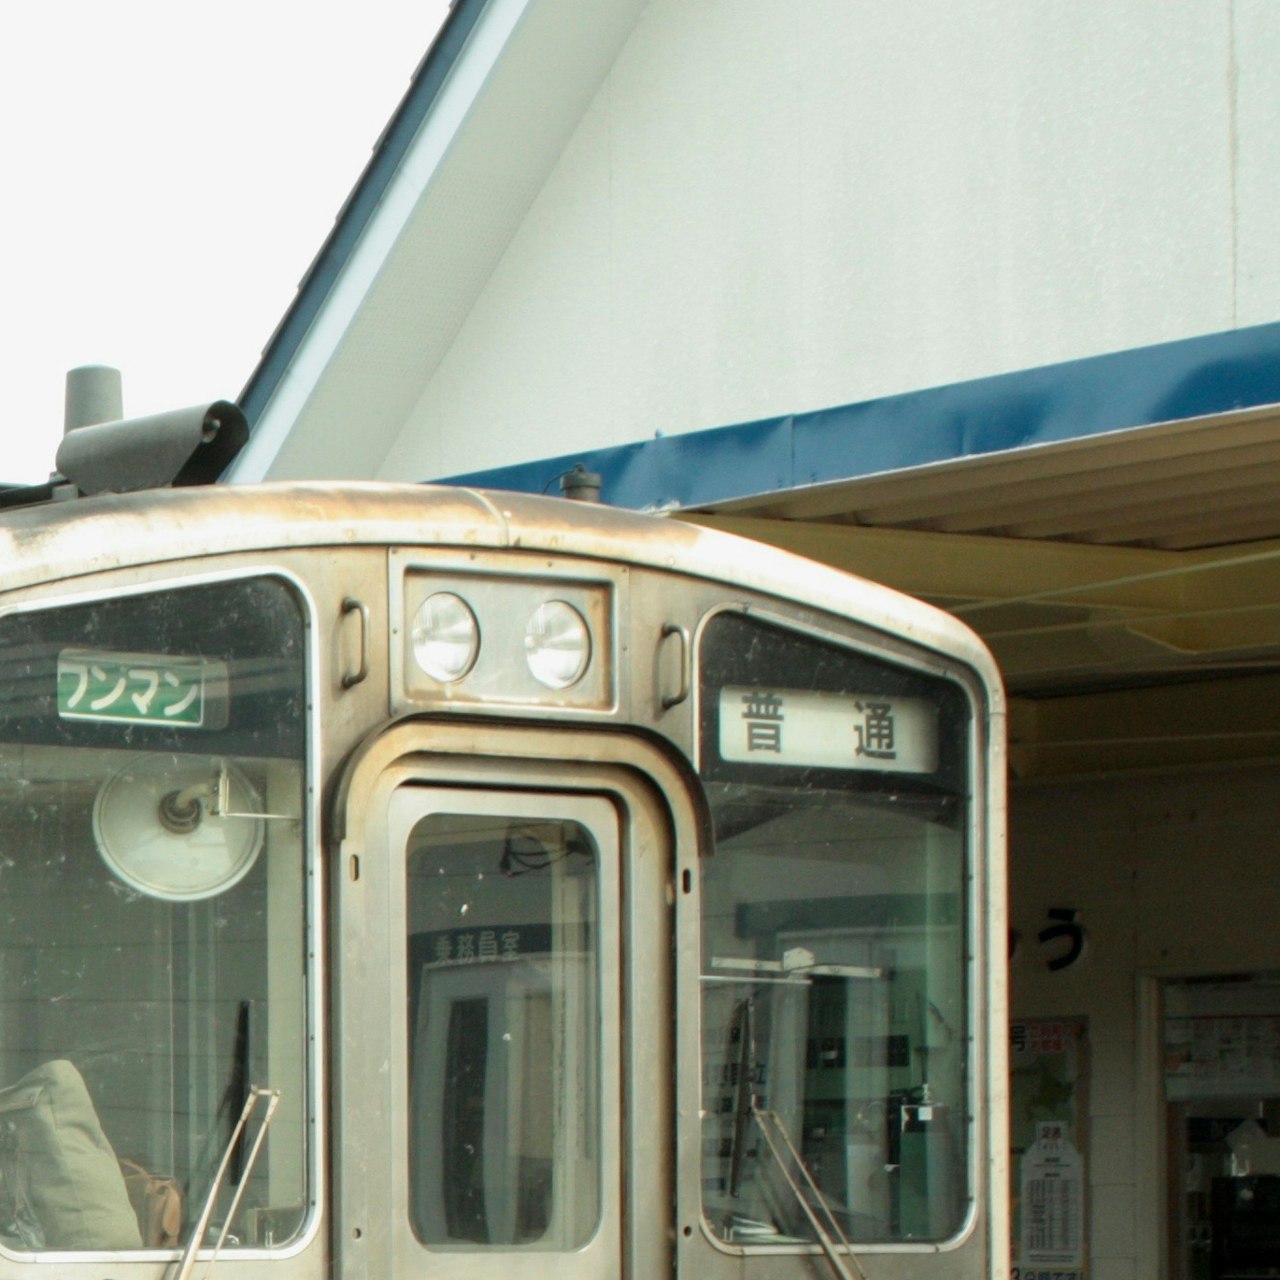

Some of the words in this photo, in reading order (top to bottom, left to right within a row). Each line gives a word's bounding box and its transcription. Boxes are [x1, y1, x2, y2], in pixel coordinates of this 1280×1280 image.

[57, 663, 198, 716] ワンマン
[741, 691, 897, 760] 普通
[436, 930, 521, 964] 乗務員室
